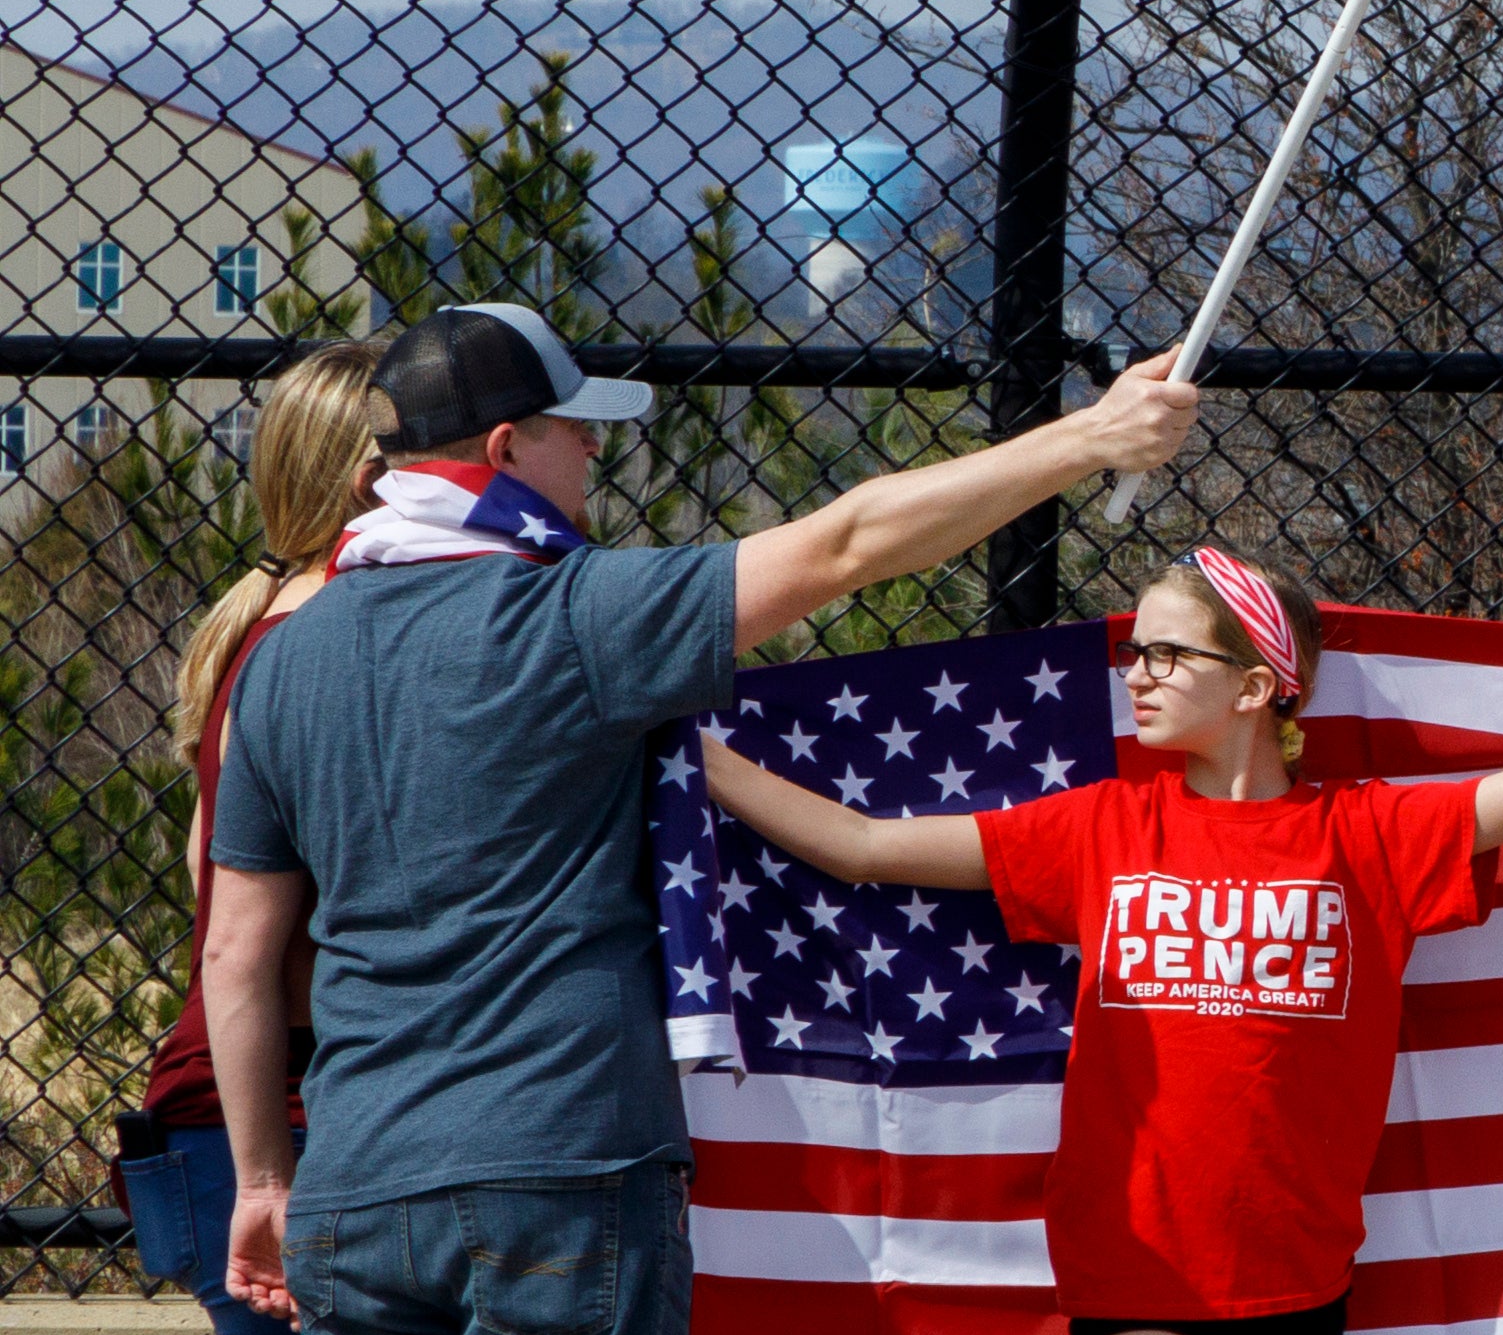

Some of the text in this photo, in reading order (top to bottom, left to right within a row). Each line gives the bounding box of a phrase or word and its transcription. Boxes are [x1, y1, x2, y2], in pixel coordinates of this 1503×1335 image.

[1112, 879, 1345, 942] TRUMP
[1117, 935, 1338, 990] PENCE
[1126, 982, 1326, 1008] KEEP AMERICA GREAT!
[1196, 1000, 1245, 1016] 2020
